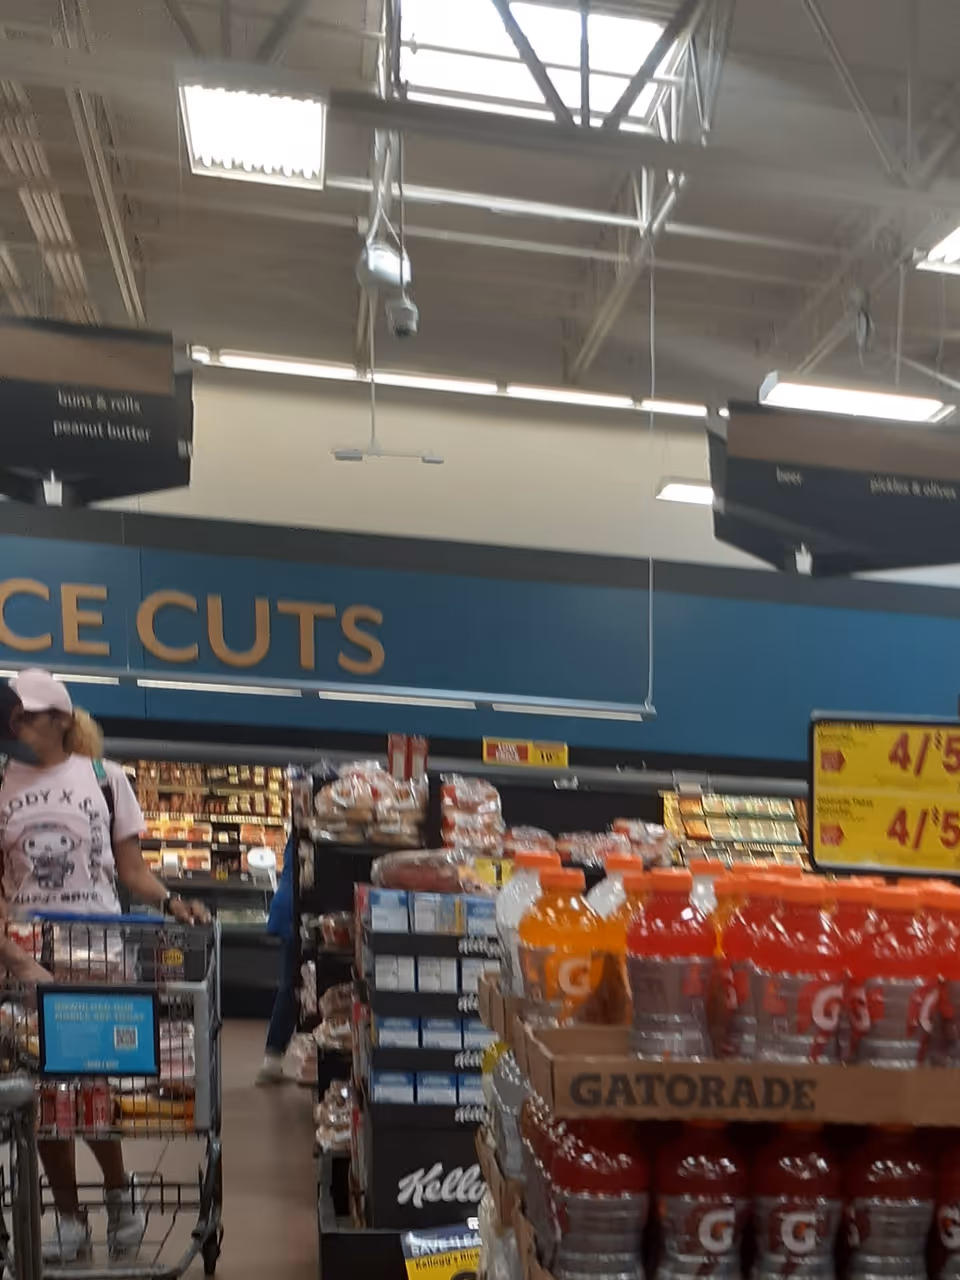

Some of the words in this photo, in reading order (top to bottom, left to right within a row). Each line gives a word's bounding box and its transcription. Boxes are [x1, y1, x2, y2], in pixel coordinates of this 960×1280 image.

[111, 396, 142, 414] rolls
[54, 420, 102, 437] peanut
[107, 421, 150, 442] butter
[136, 589, 385, 676] CUTS
[569, 1072, 817, 1112] GATORADE
[699, 1208, 735, 1252] G
[781, 1209, 817, 1252] G
